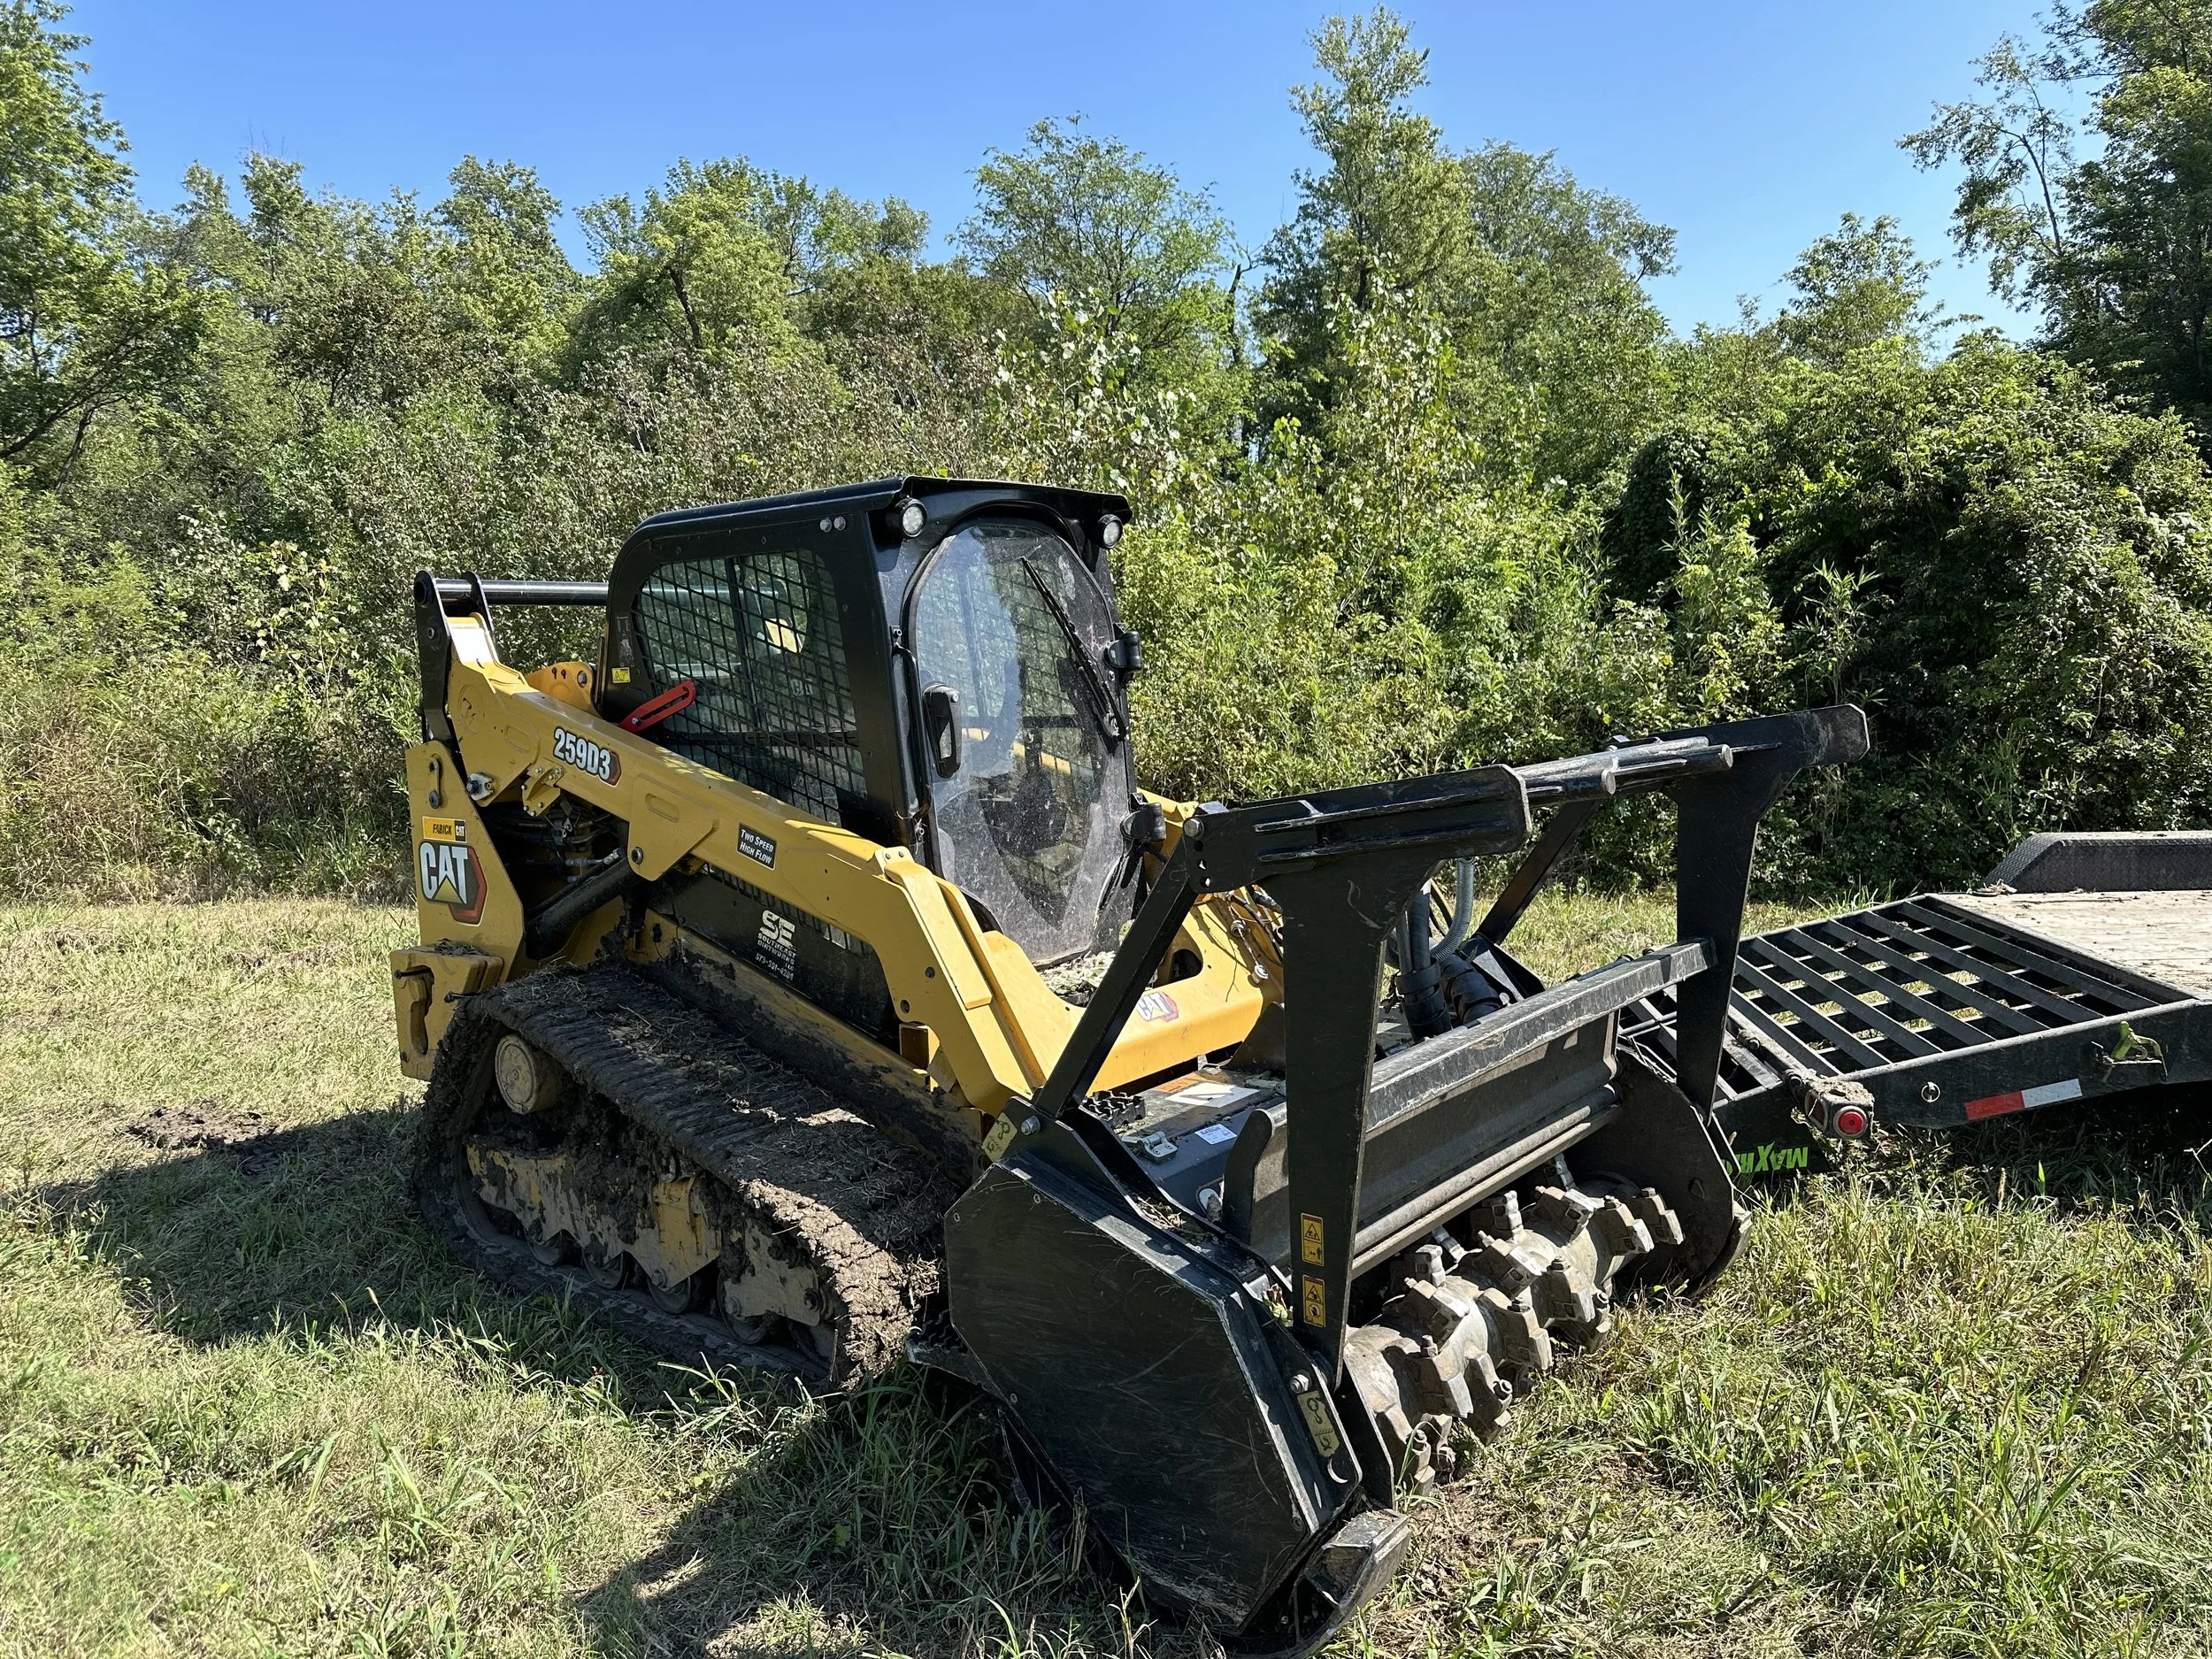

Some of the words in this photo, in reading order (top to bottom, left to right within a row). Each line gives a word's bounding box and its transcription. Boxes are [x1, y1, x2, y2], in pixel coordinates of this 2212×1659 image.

[553, 727, 611, 780] 259D3
[433, 824, 452, 835] FABICK
[455, 826, 465, 836] CAT
[419, 842, 468, 904] CAT
[757, 932, 797, 959] SOUTHEAST
[757, 939, 795, 966] DIRTWORKS
